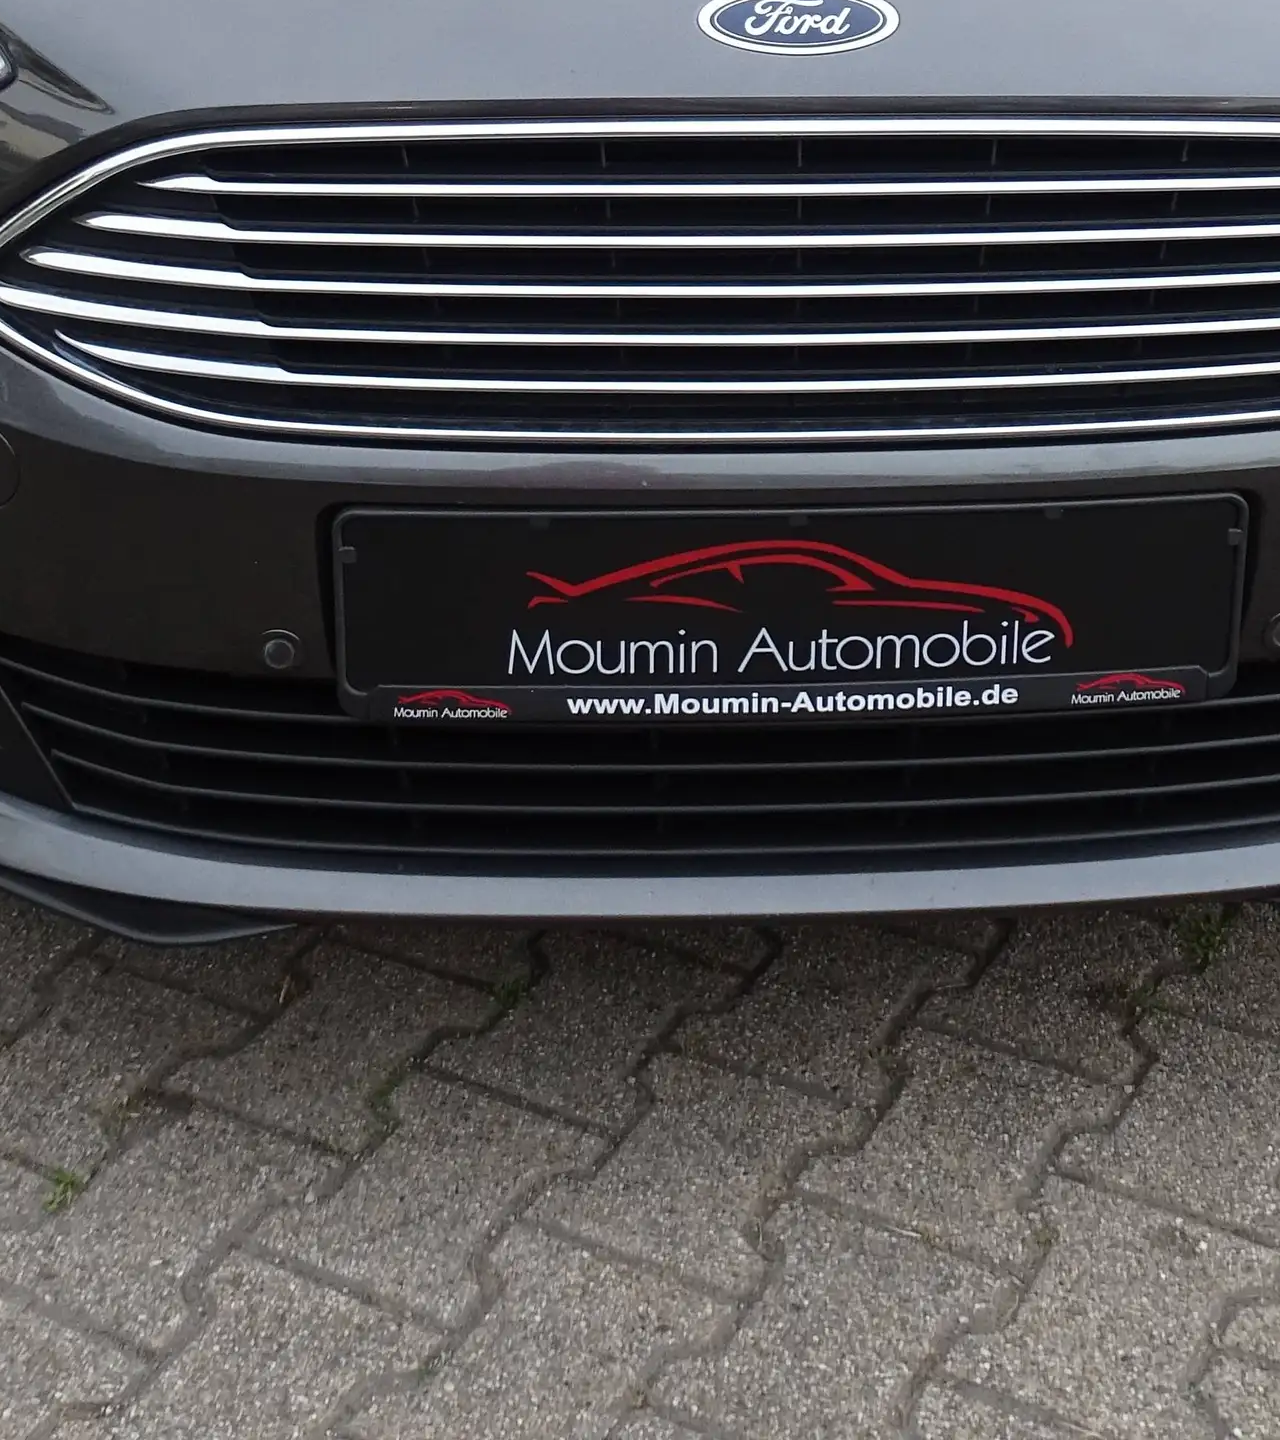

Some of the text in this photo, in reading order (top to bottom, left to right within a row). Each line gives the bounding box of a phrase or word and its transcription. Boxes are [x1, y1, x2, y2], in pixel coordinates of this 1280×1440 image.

[507, 619, 1056, 676] Moumin Automobile
[566, 683, 1019, 716] www.Moumin-Automobile.de
[1071, 688, 1181, 705] Moumin Automobile
[393, 706, 508, 719] Moumin Automobile
